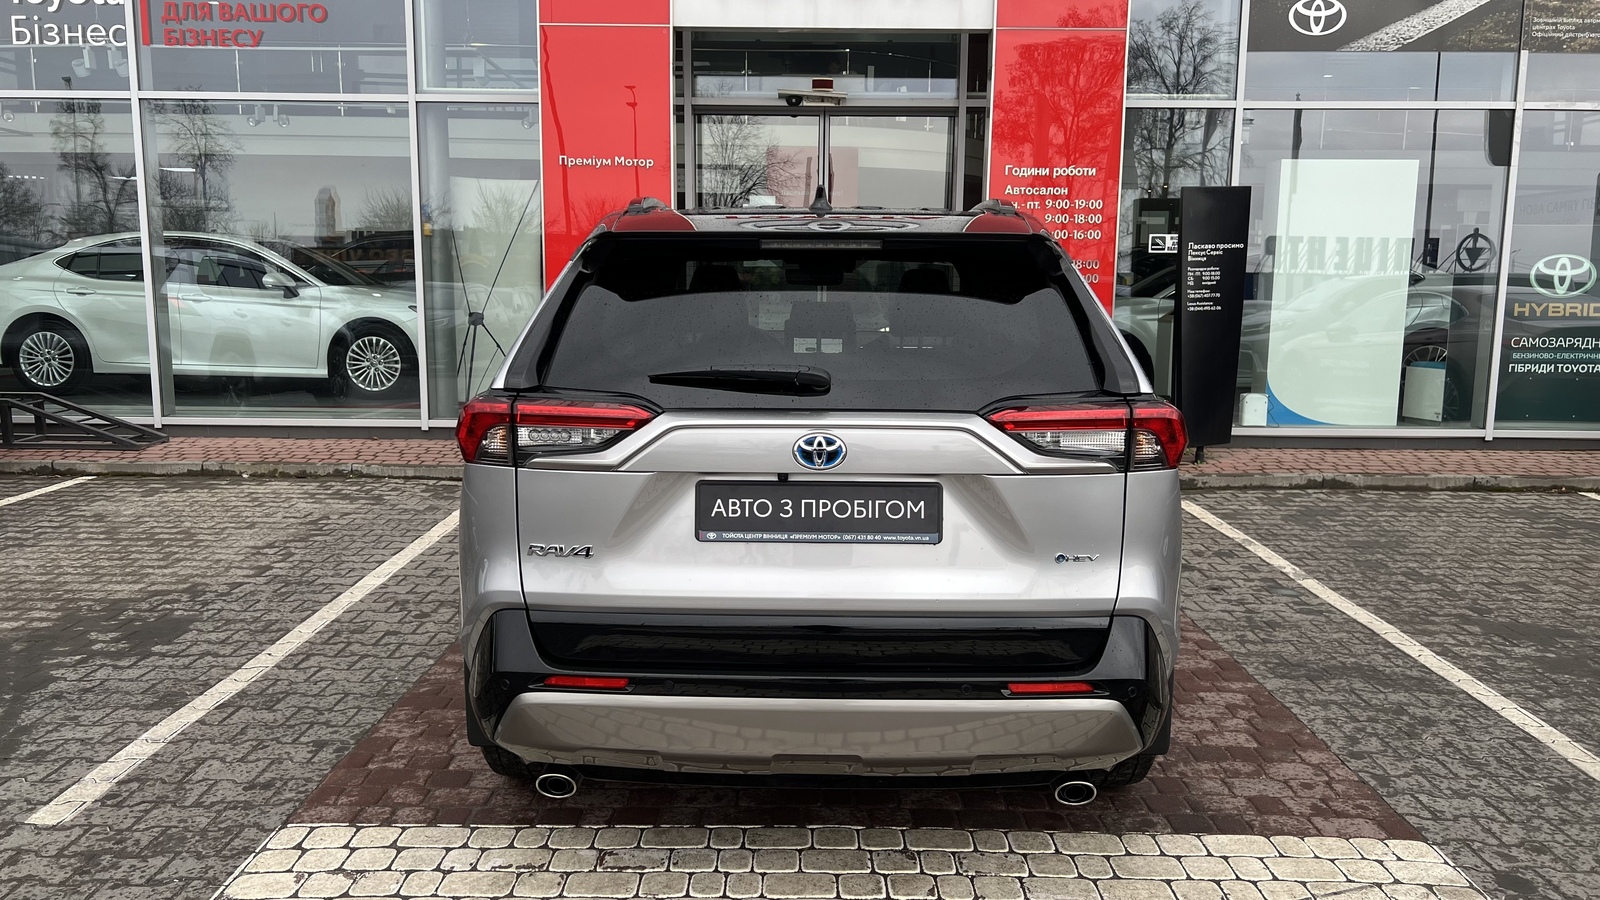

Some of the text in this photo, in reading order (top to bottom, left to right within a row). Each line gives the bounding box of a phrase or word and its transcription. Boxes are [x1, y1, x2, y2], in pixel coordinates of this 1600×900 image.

[161, 1, 328, 25] ДЛЯ ВАШОГО
[11, 15, 127, 46] Бізнес
[163, 28, 264, 48] БІЗНЕСУ
[559, 155, 654, 169] Преміум Мотор
[1004, 165, 1097, 178] Години роботи
[1004, 184, 1069, 196] Автосалон
[1045, 199, 1103, 210] 9:00-19:00
[1045, 213, 1103, 224] 9:00-18:00
[1051, 229, 1102, 240] :00-16:00
[1188, 242, 1216, 250] Ласкаво
[1513, 302, 1600, 317] HYBRID
[1508, 363, 1600, 374] ГІБРИДИ TOYOTA
[711, 498, 925, 519] АВТО З ПРОБІГОМ
[883, 534, 930, 542] www.toyota.vn.ua
[527, 543, 594, 559] RAV4
